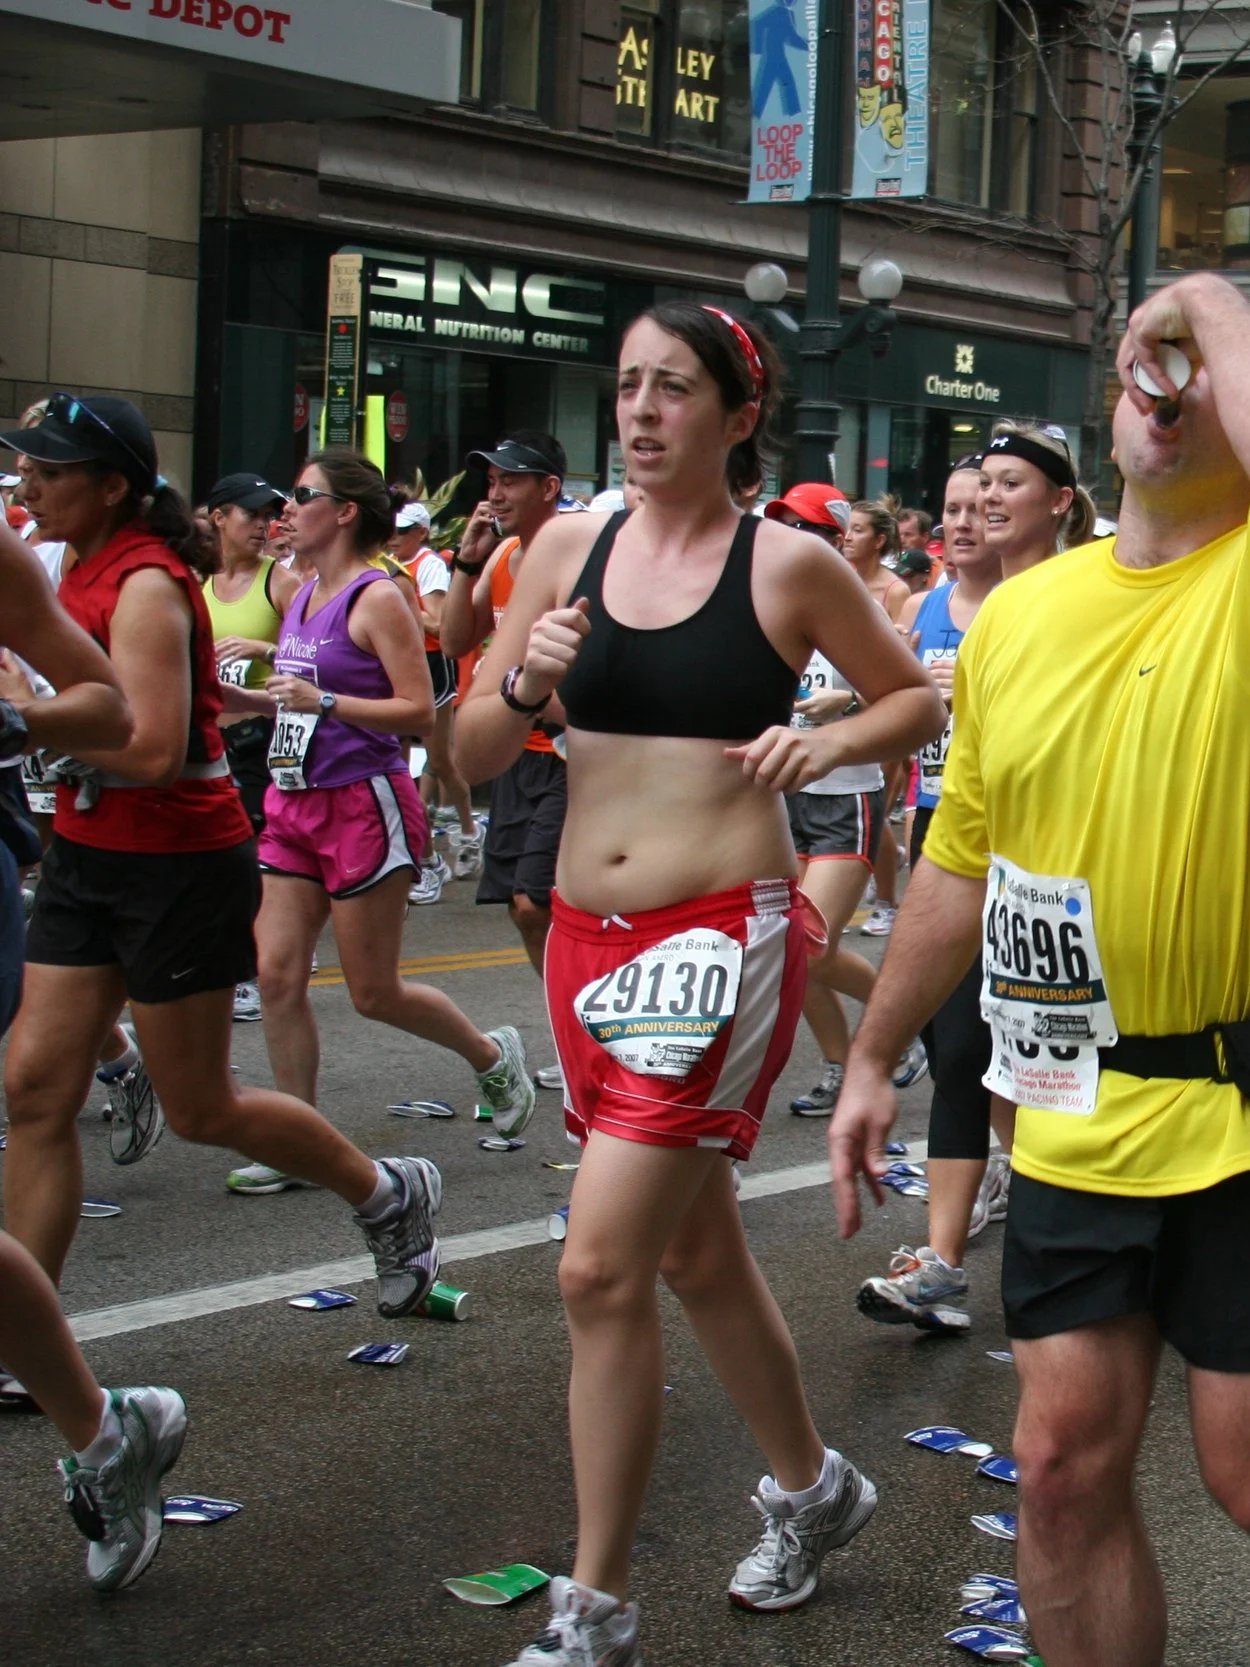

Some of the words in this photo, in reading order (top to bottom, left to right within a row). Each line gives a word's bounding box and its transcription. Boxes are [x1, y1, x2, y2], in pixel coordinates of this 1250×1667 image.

[148, 0, 291, 44] DEPOT
[904, 19, 928, 172] THEATRE
[757, 124, 804, 145] LOOP
[763, 143, 797, 162] THE
[755, 161, 803, 182] LOOP
[345, 247, 605, 325] GNC
[434, 318, 526, 345] NUTRITION
[532, 331, 589, 353] CENTER
[926, 374, 974, 399] Charter
[974, 382, 1001, 402] One
[1030, 888, 1064, 906] Bank
[685, 939, 719, 952] Bank
[987, 898, 1090, 984] 43696
[583, 962, 728, 1017] 29130
[1008, 983, 1093, 1001] ANNIVERSARY
[598, 1023, 622, 1039] 30th
[624, 1020, 720, 1035] ANNIVERSARY
[1021, 1066, 1051, 1080] LaSalle
[1052, 1068, 1077, 1080] Bank
[1038, 1079, 1082, 1090] Marathon
